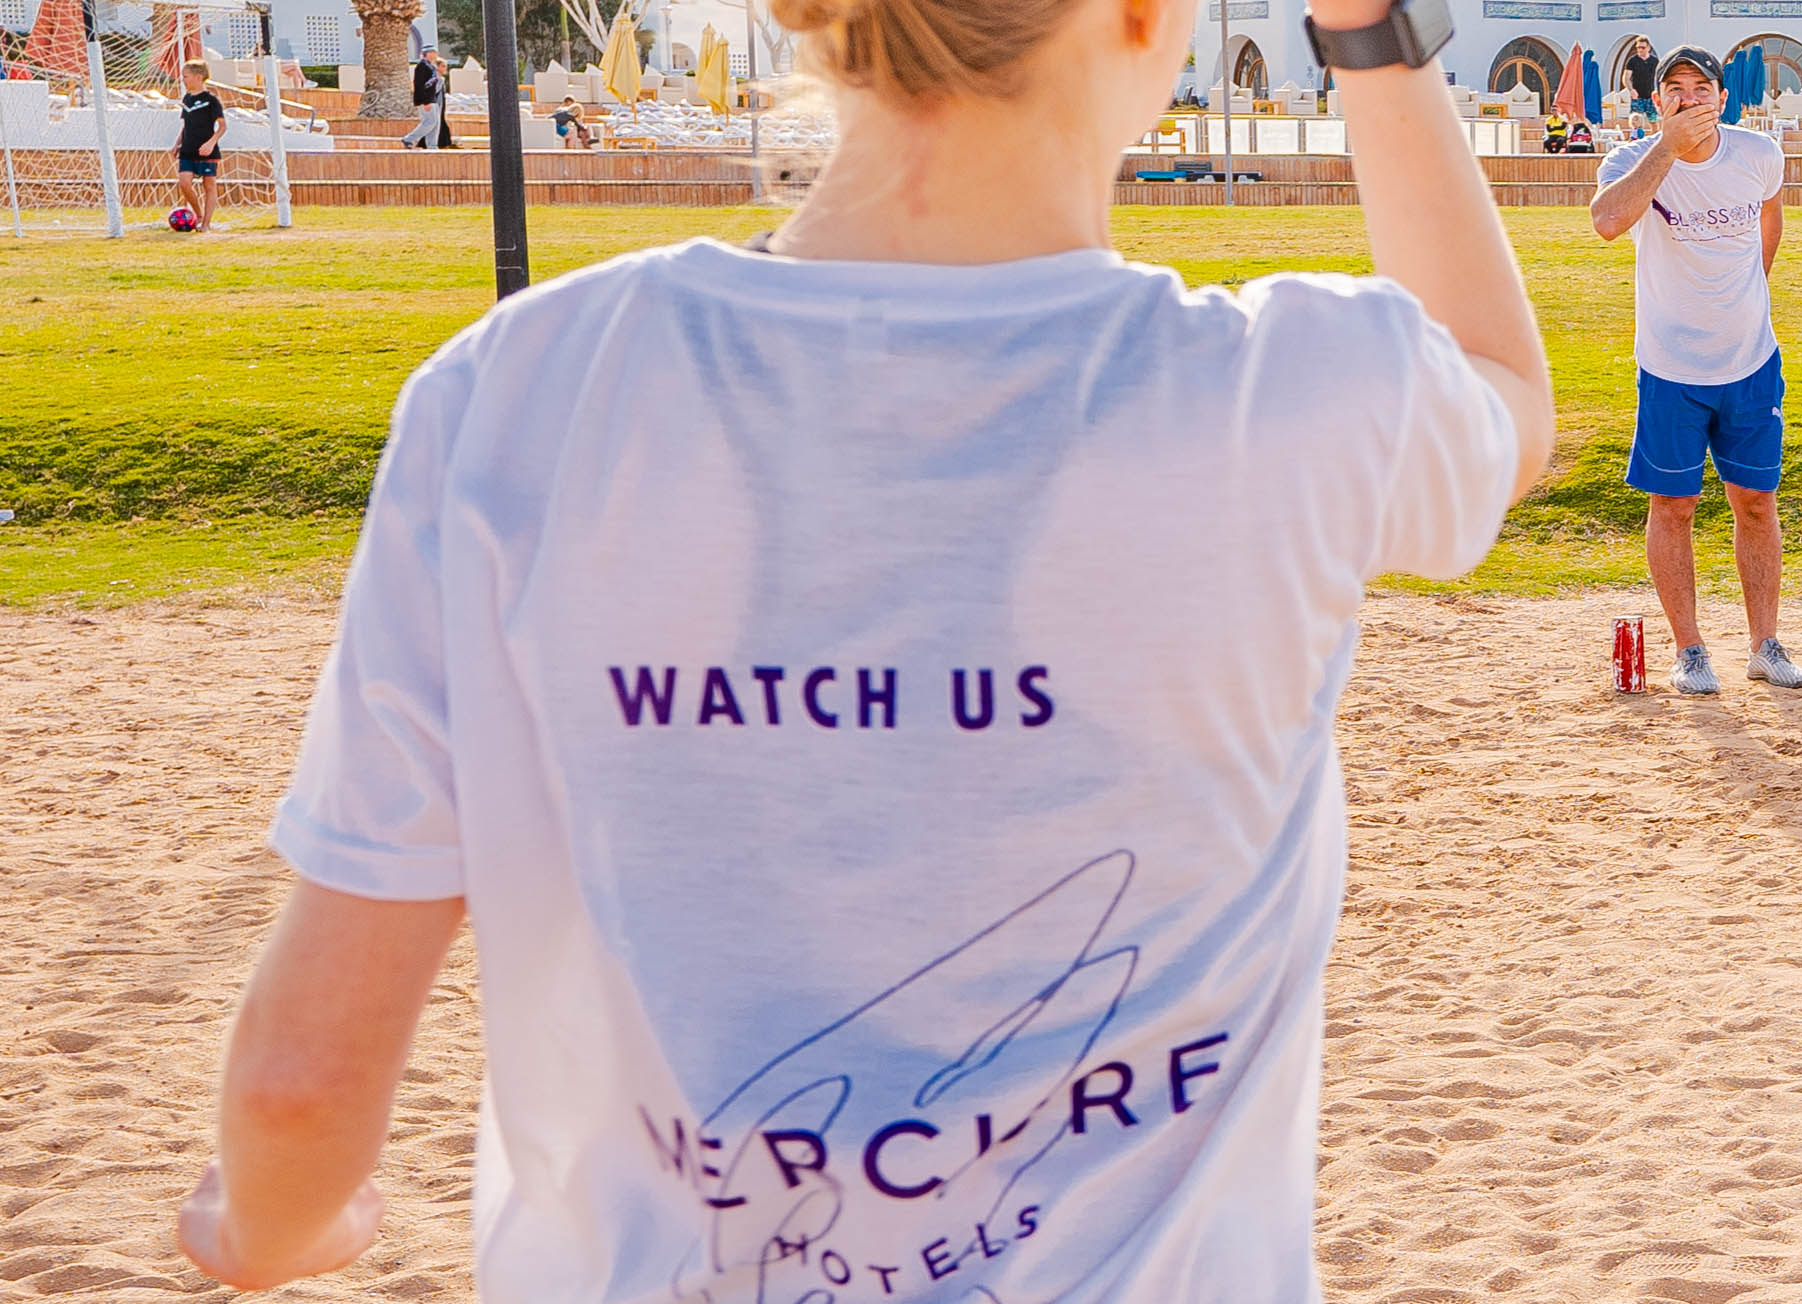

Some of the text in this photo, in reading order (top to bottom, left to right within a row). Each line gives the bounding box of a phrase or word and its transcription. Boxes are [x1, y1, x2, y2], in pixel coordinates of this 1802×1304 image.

[608, 665, 1055, 731] WATCH US
[770, 1203, 1040, 1297] HOTELS
